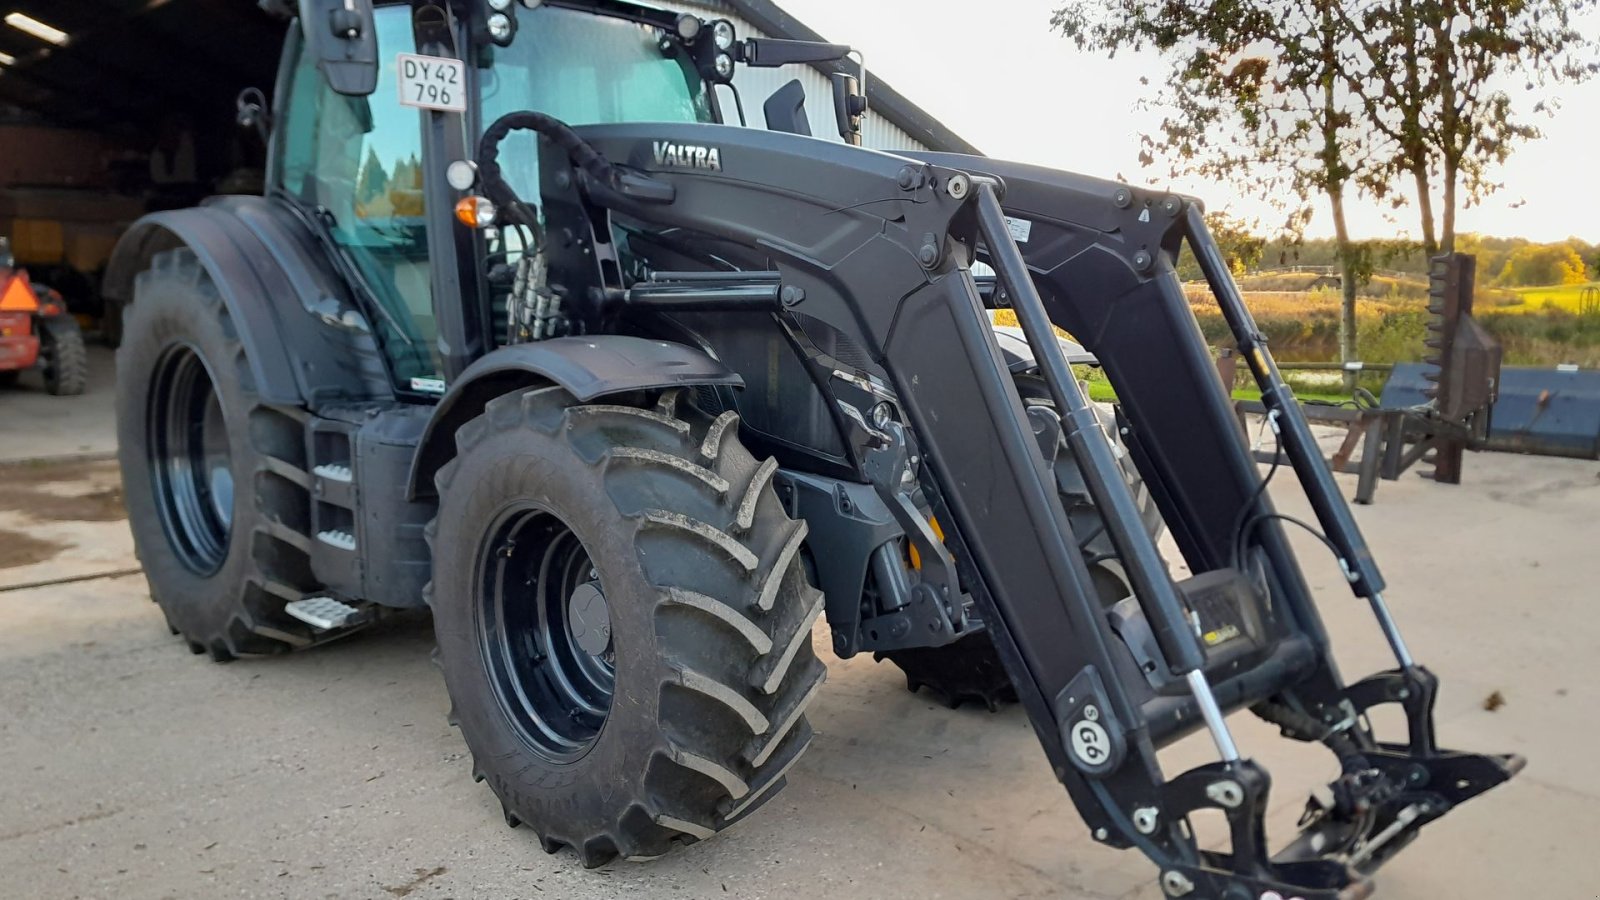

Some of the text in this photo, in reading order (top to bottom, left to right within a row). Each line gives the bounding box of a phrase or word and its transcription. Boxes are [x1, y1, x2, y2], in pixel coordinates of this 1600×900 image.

[414, 83, 451, 105] 796
[652, 141, 722, 170] VALTRA
[1079, 727, 1105, 759] G6
